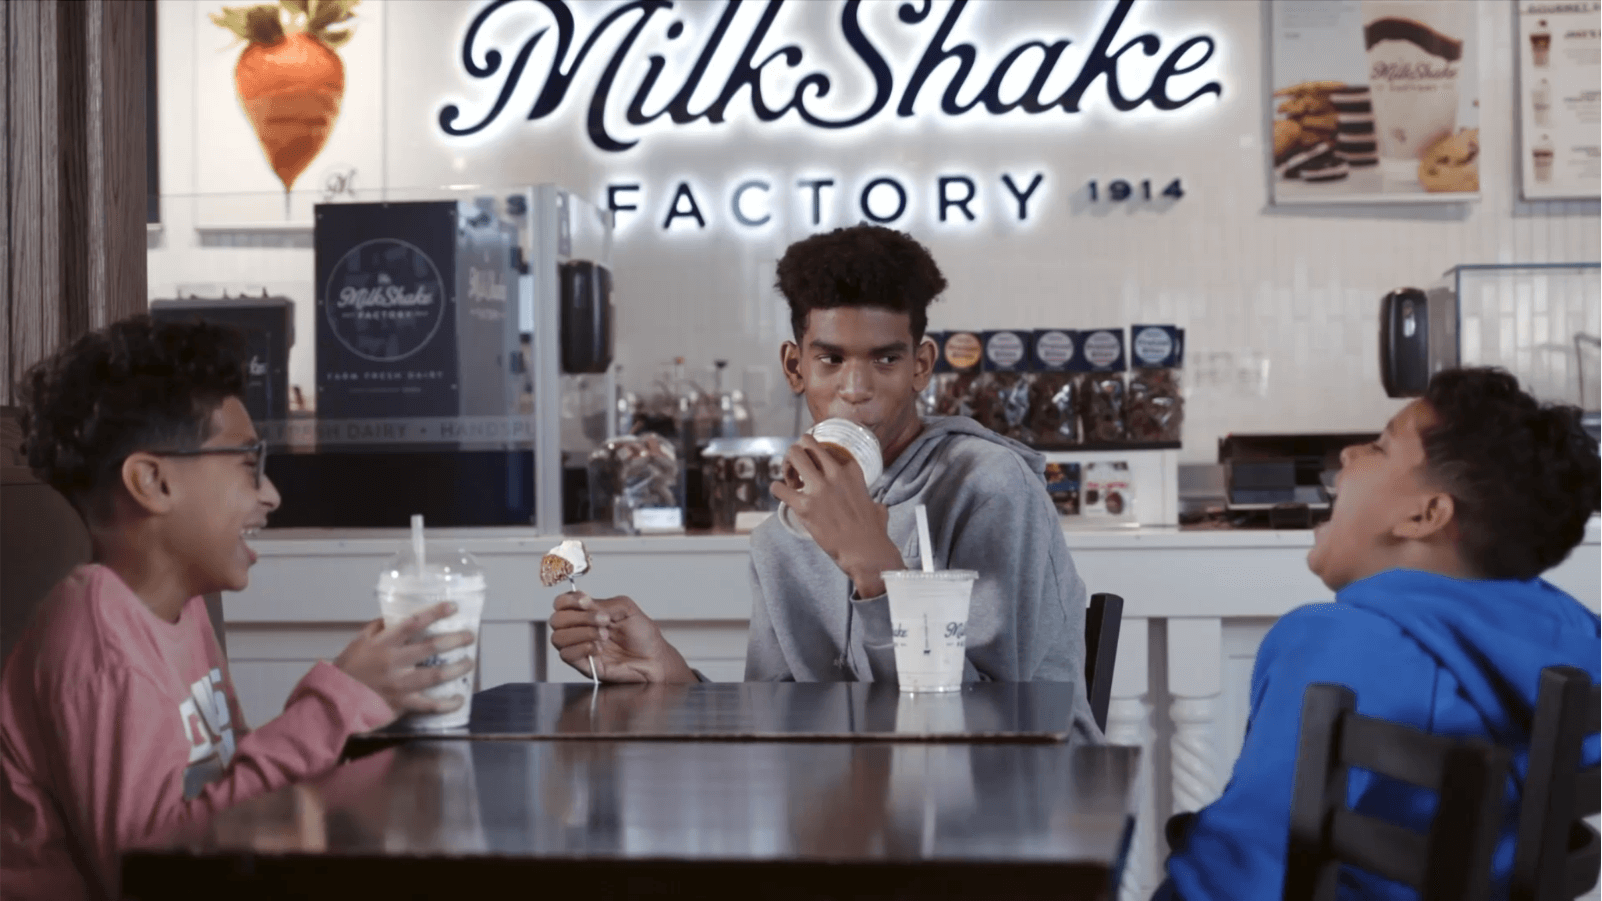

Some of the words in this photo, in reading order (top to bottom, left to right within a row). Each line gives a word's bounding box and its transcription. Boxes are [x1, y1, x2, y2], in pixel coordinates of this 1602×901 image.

[438, 0, 1222, 153] MilkShake
[607, 174, 1043, 229] FACTORY
[1088, 177, 1184, 202] 1914
[337, 284, 434, 309] MilkShake
